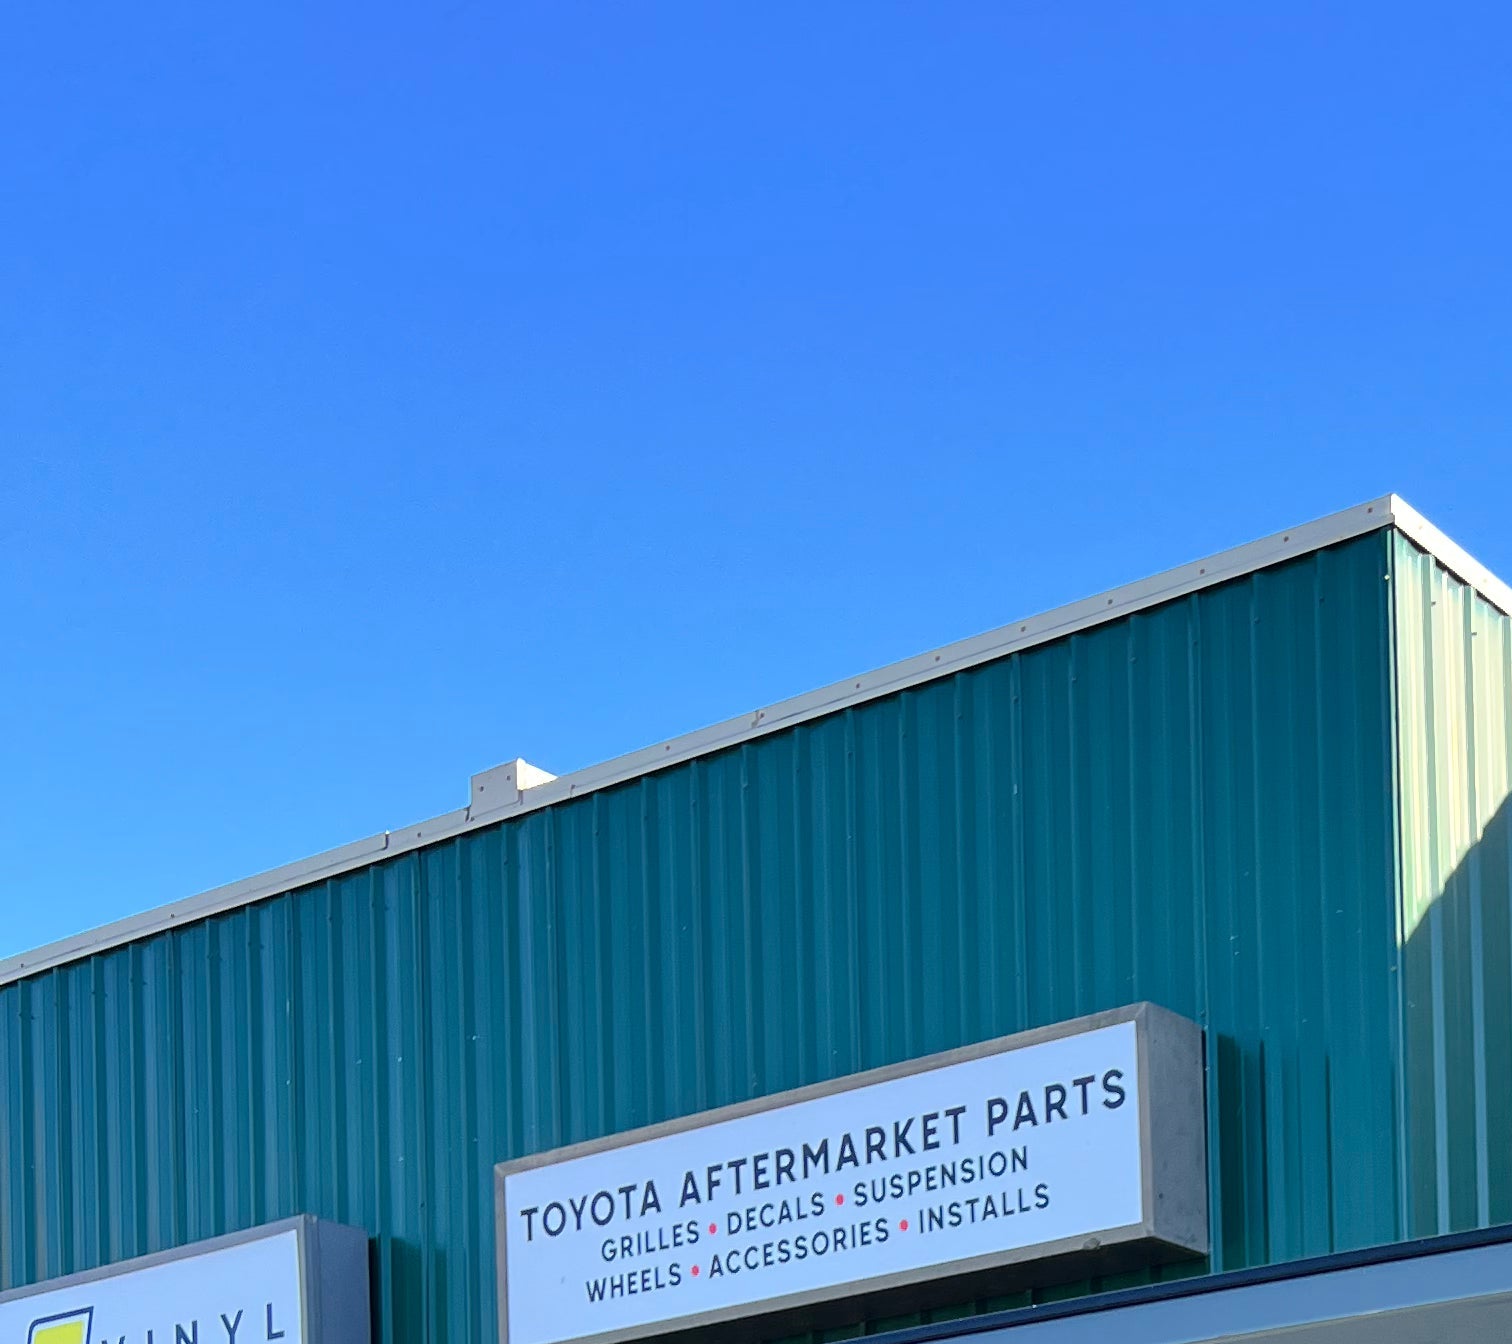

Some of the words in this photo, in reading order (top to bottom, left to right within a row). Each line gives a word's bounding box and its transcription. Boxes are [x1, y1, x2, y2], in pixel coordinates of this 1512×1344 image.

[520, 1180, 662, 1242] TOYOTA
[679, 1105, 967, 1208] AFTERMARKET
[987, 1069, 1126, 1137] PARTS
[601, 1220, 700, 1262] GRILLES
[727, 1192, 825, 1235] DECALS
[854, 1145, 1028, 1207] SUSPENSION
[586, 1262, 682, 1303] WHEELS
[709, 1217, 889, 1279] ACCESSORIES
[919, 1183, 1050, 1234] INSTALLS
